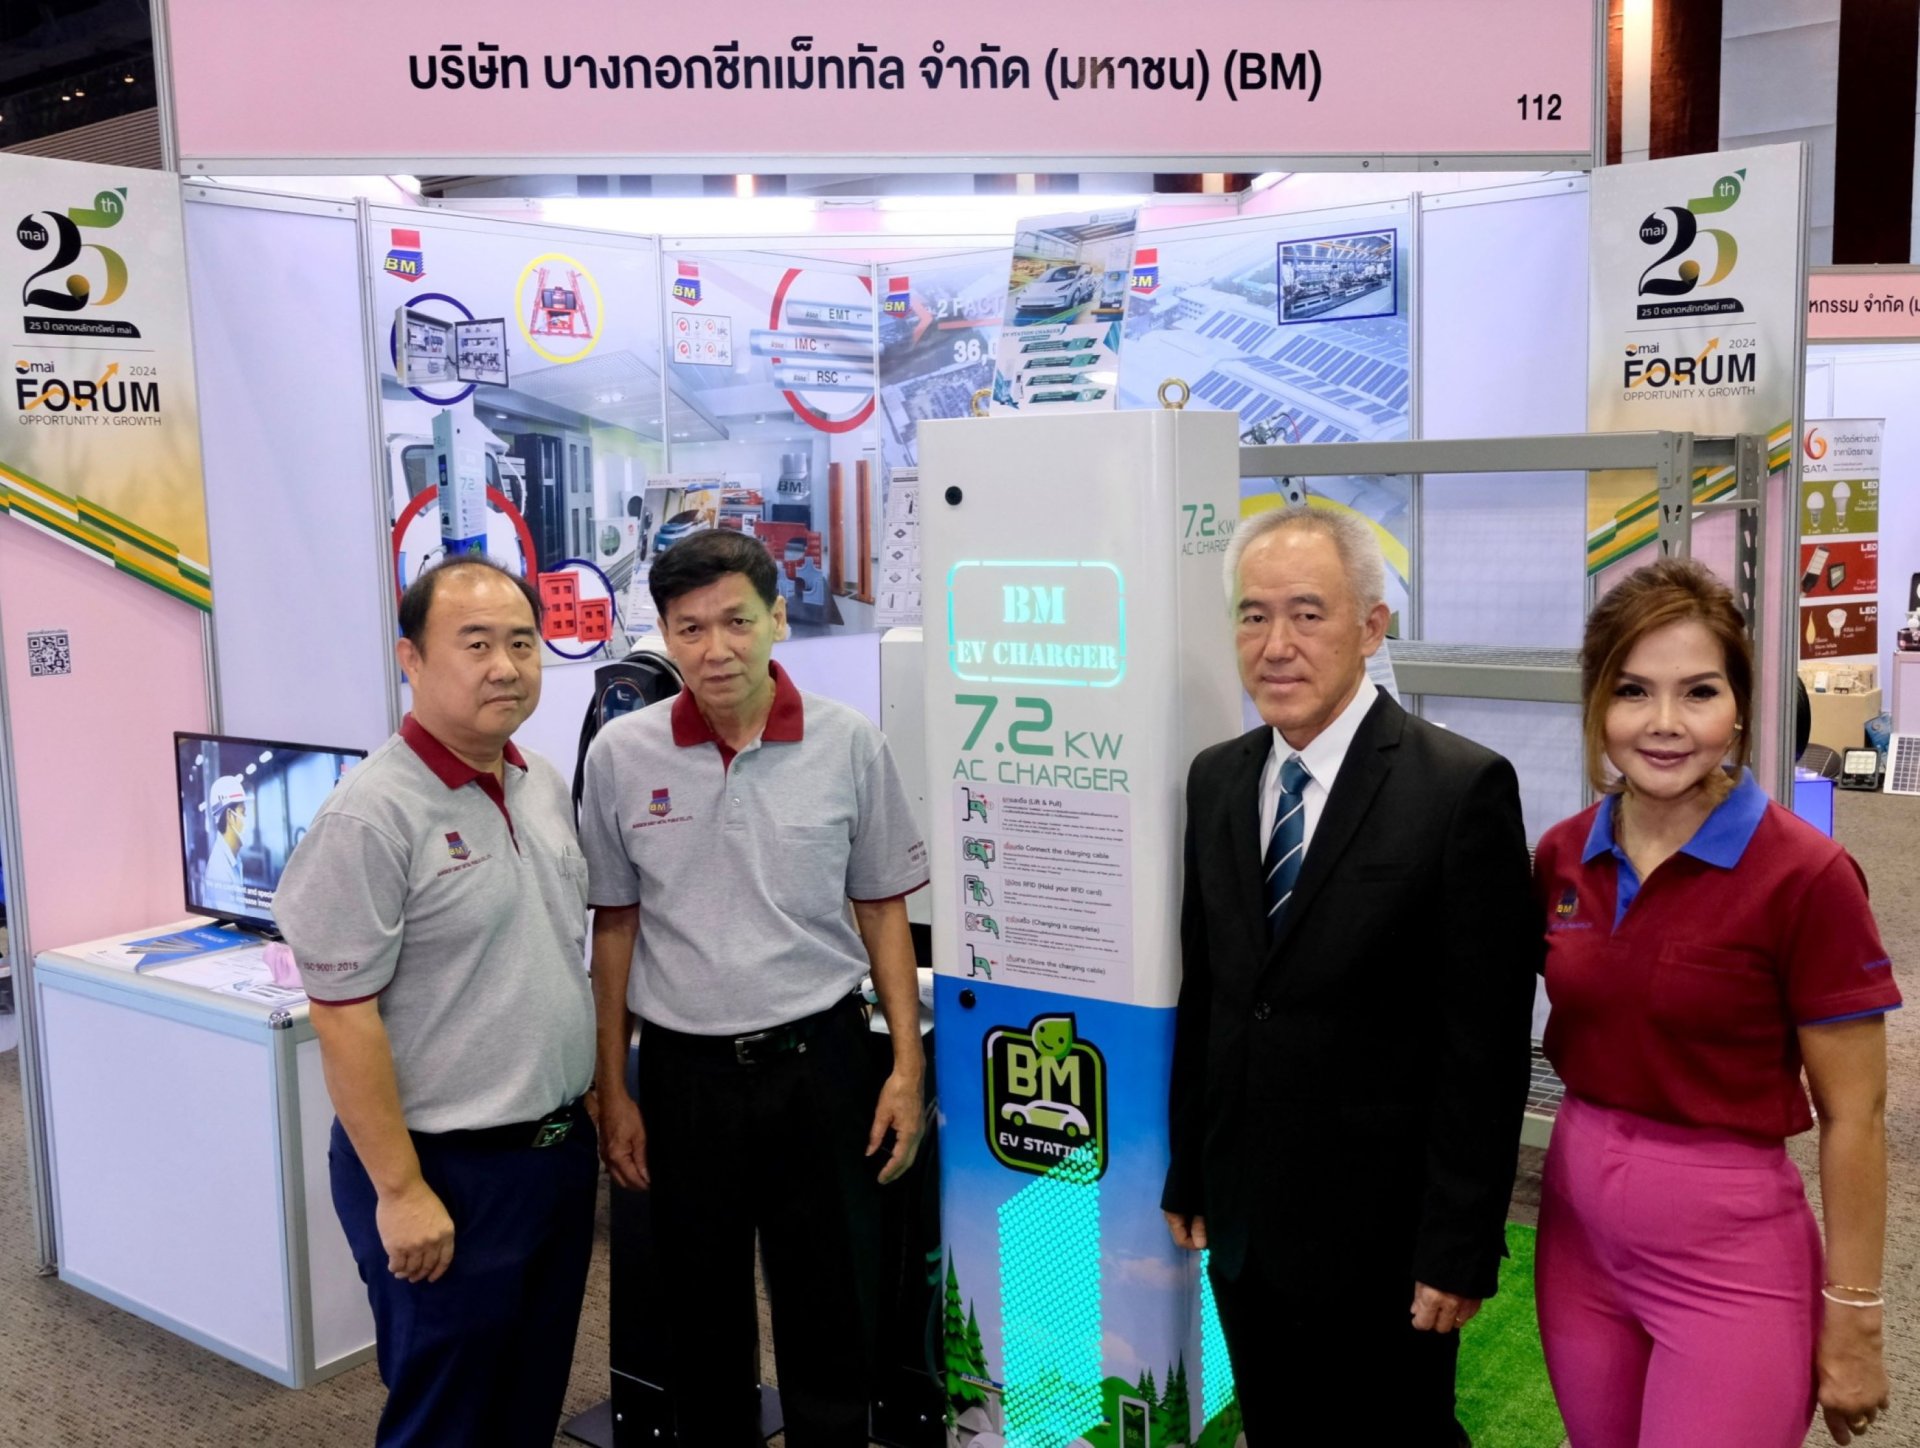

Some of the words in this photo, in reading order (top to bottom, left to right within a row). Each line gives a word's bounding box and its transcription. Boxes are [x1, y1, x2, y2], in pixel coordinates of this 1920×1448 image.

[408, 42, 529, 90] บริษัท
[544, 36, 906, 90] บางกอกชีทเม็ททัล
[919, 40, 1030, 91] จำกัด
[1044, 48, 1210, 101] (มหาชน)
[1223, 49, 1322, 102] (BM)
[1517, 94, 1562, 121] 112
[1719, 182, 1735, 197] th
[101, 198, 118, 214] th
[19, 228, 46, 242] mai
[1642, 223, 1665, 238] mai
[384, 257, 417, 274] BM
[672, 285, 696, 299] BM
[884, 301, 906, 312] BM
[1642, 308, 1652, 316] 25
[1721, 301, 1736, 311] mai
[1864, 293, 1904, 314] จำกัด
[829, 308, 850, 320] EMT
[29, 321, 41, 330] 25
[117, 326, 132, 335] mai
[795, 338, 817, 351] IMC
[1638, 342, 1660, 355] mai
[1729, 338, 1756, 349] 2024
[31, 360, 55, 374] mai
[130, 366, 157, 376] 2024
[1624, 353, 1756, 389] FORUM
[817, 371, 839, 384] RSC
[16, 378, 160, 413] FORUM
[1624, 389, 1695, 401] OPPORTUNITY
[1698, 387, 1705, 398] X
[1708, 386, 1755, 397] GROWTH
[19, 415, 98, 426] OPPORTUNITY
[102, 416, 110, 426] X
[113, 416, 161, 427] GROWTH
[1803, 464, 1828, 474] GATA
[777, 480, 802, 493] BM
[1862, 481, 1878, 489] LED
[1182, 503, 1215, 538] 7.2
[1218, 519, 1236, 535] KW
[1182, 542, 1194, 555] AC
[1861, 543, 1877, 551] LED
[1003, 585, 1066, 624] BM
[1860, 606, 1877, 614] LED
[957, 641, 986, 663] EV
[993, 641, 1118, 670] CHARGER
[955, 694, 1054, 757] 7.2
[1065, 731, 1123, 760] KW
[953, 759, 987, 781] AC
[999, 762, 1130, 793] CHARGER
[649, 803, 666, 811] BM
[1026, 845, 1050, 853] Connect
[1064, 849, 1091, 859] charging
[1023, 881, 1036, 889] RFID
[1071, 886, 1084, 894] RFID
[1556, 904, 1573, 913] BM
[337, 962, 358, 972] 2015
[1059, 963, 1085, 973] charging
[1007, 1043, 1081, 1107] BM
[1000, 1132, 1019, 1147] EV
[1023, 1137, 1092, 1161] STATIO
